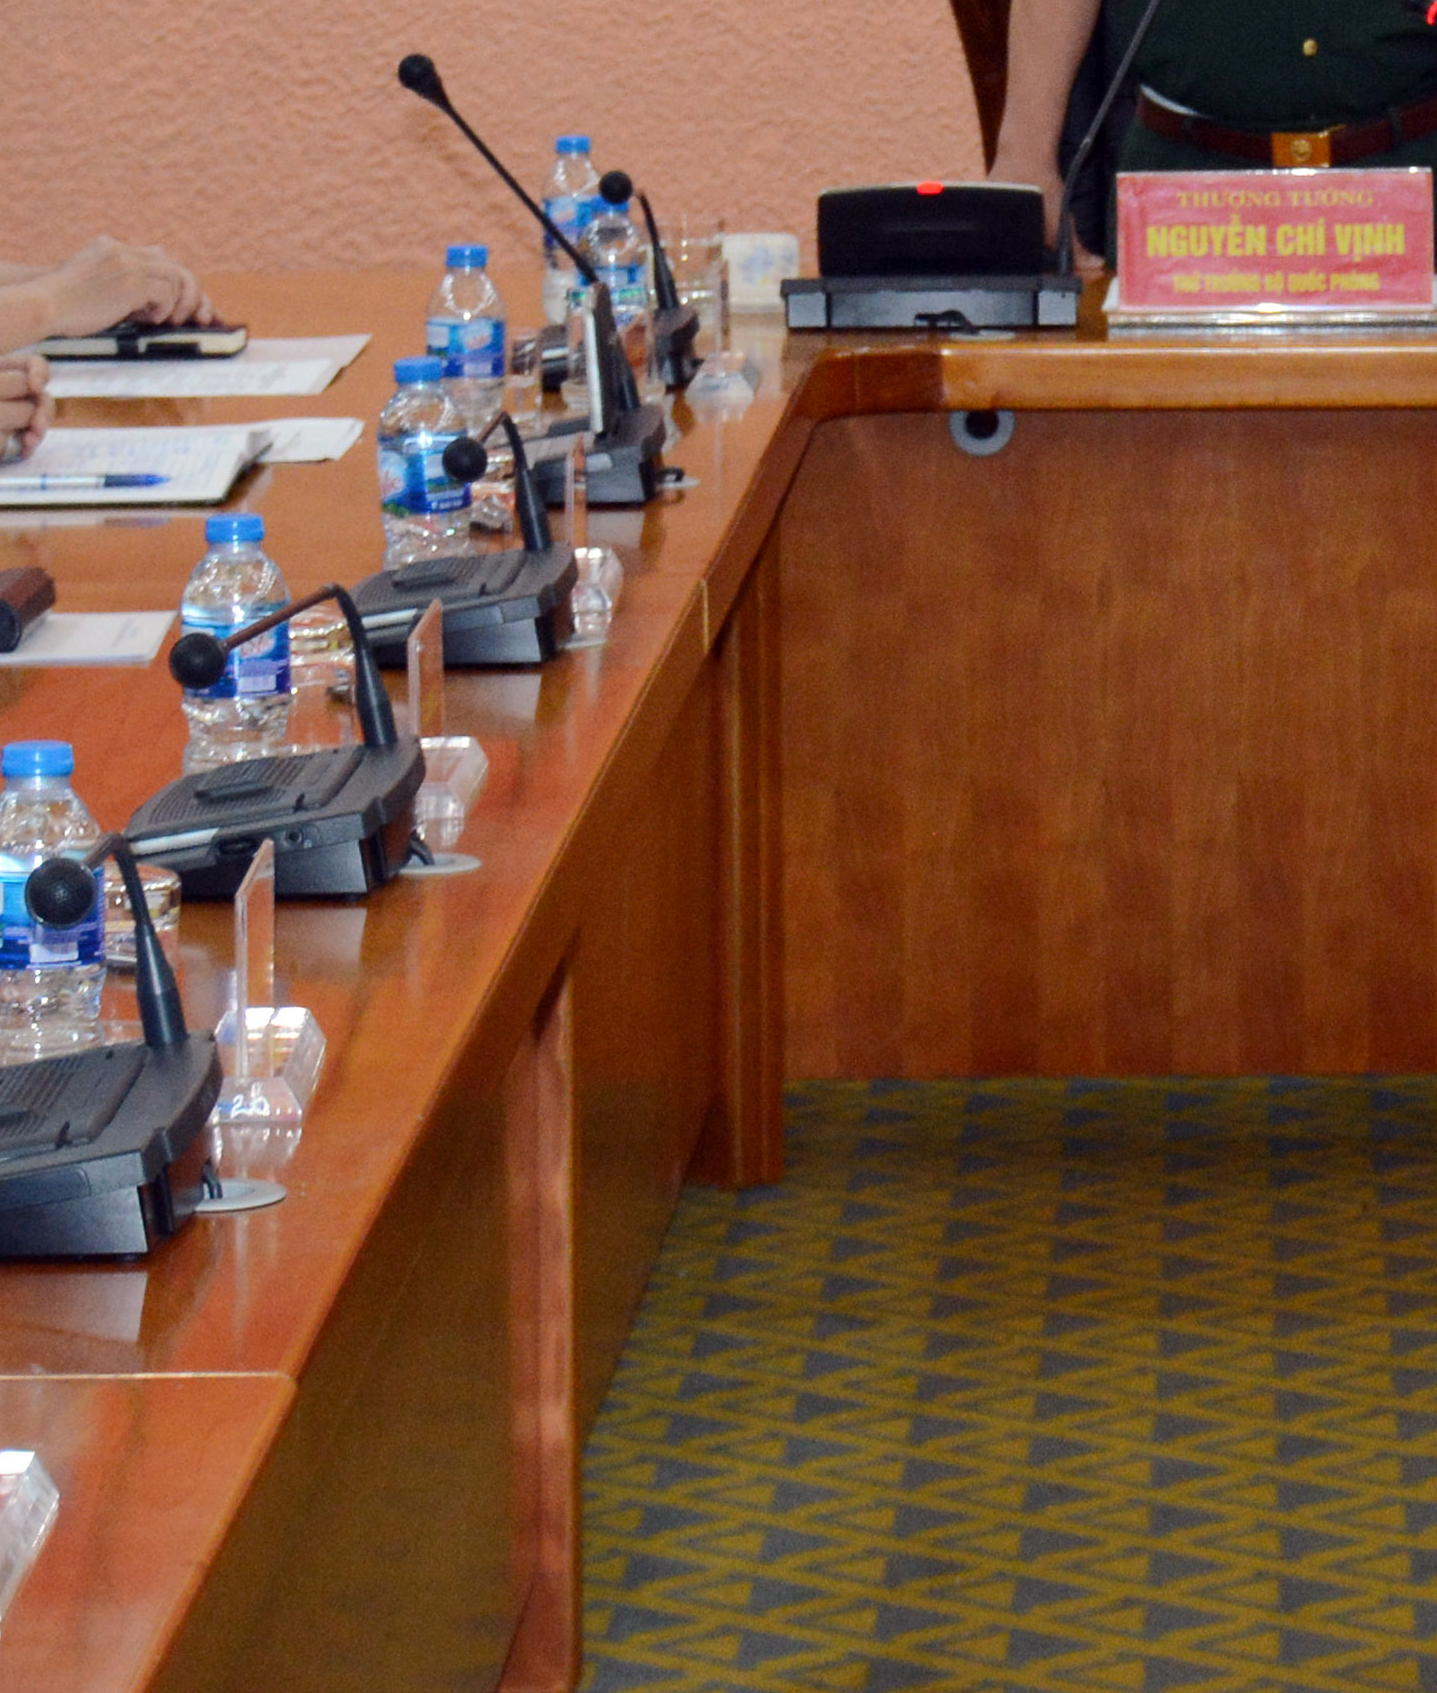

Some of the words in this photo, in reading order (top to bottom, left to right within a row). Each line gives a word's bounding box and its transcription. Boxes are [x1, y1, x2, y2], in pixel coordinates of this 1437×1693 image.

[1146, 215, 1267, 257] NGUYỄN
[1276, 218, 1326, 256] CHÍ
[1334, 223, 1405, 262] VỊNH
